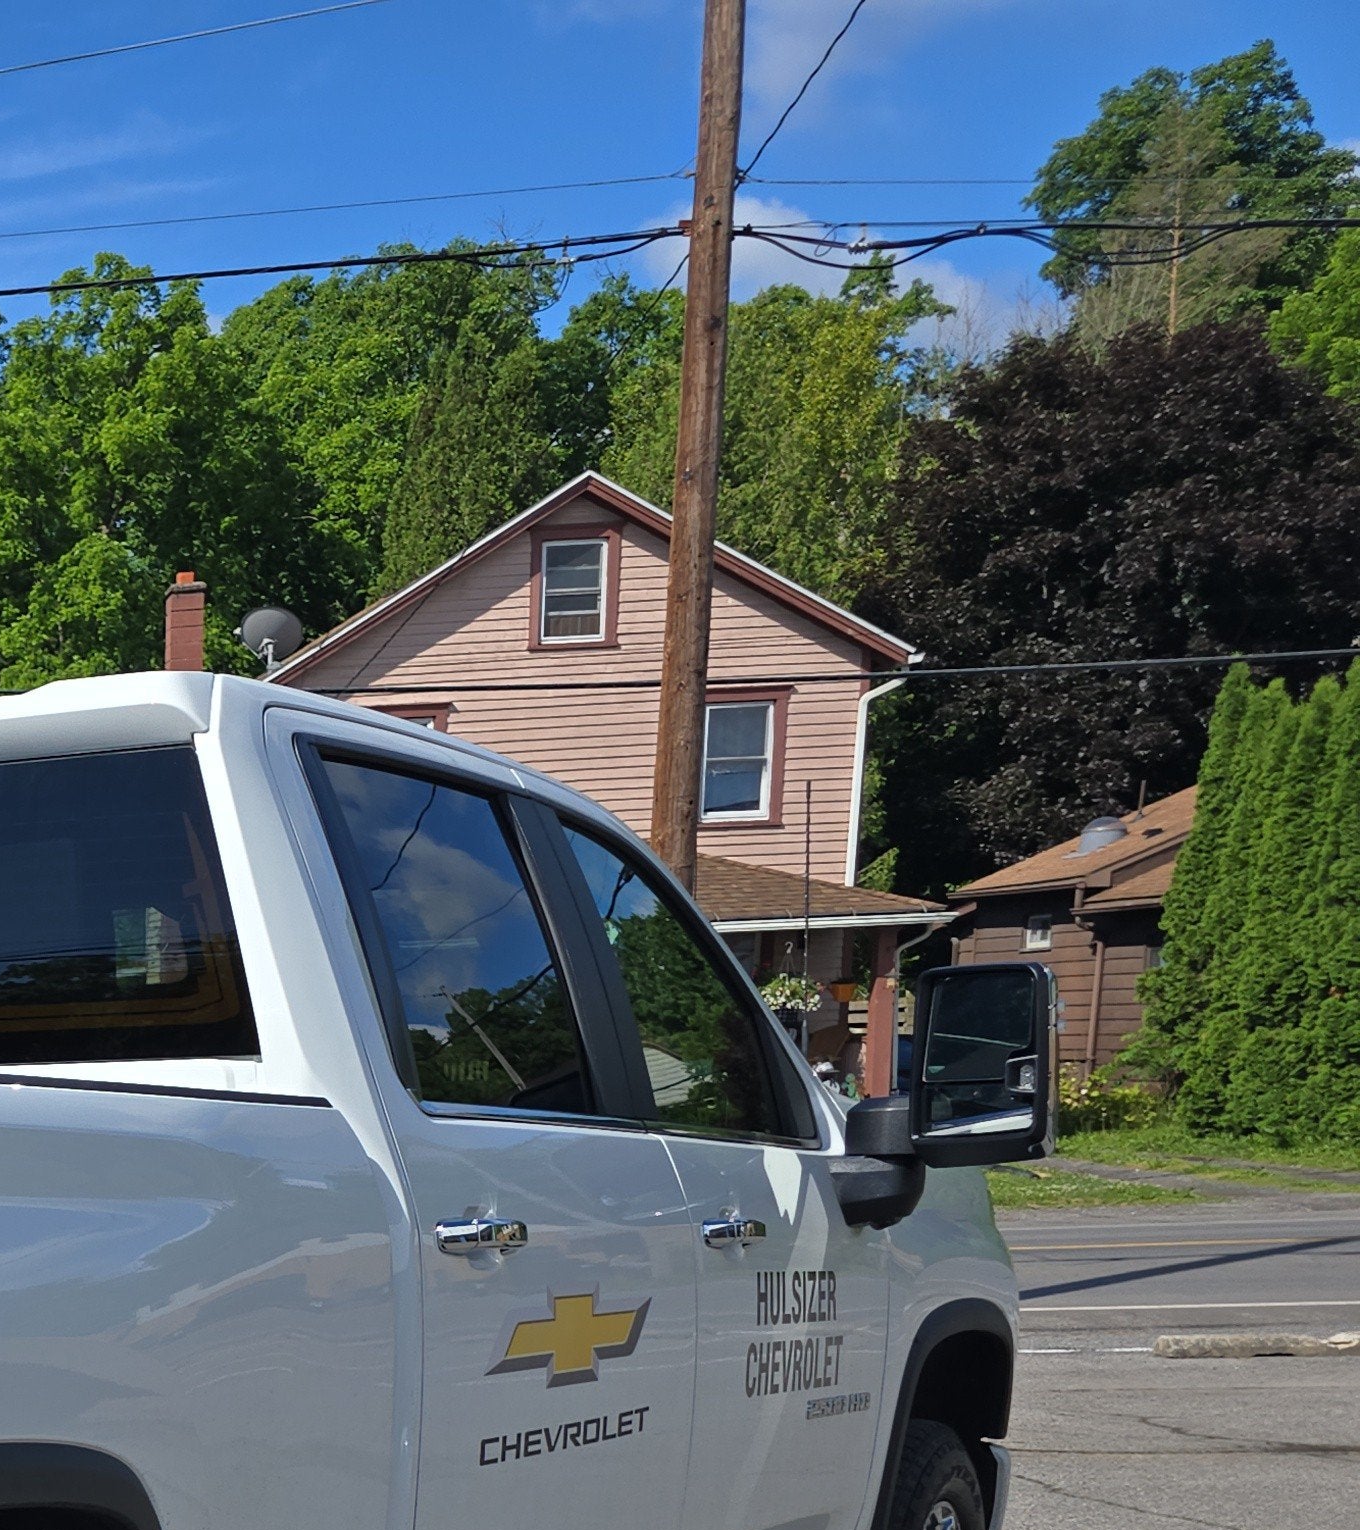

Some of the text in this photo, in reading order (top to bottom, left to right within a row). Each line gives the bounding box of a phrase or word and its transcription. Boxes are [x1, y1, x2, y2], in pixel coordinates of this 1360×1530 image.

[756, 1270, 837, 1326] HULSIZER
[745, 1335, 844, 1398] CHEVROLET
[479, 1406, 650, 1466] CHEVROLET
